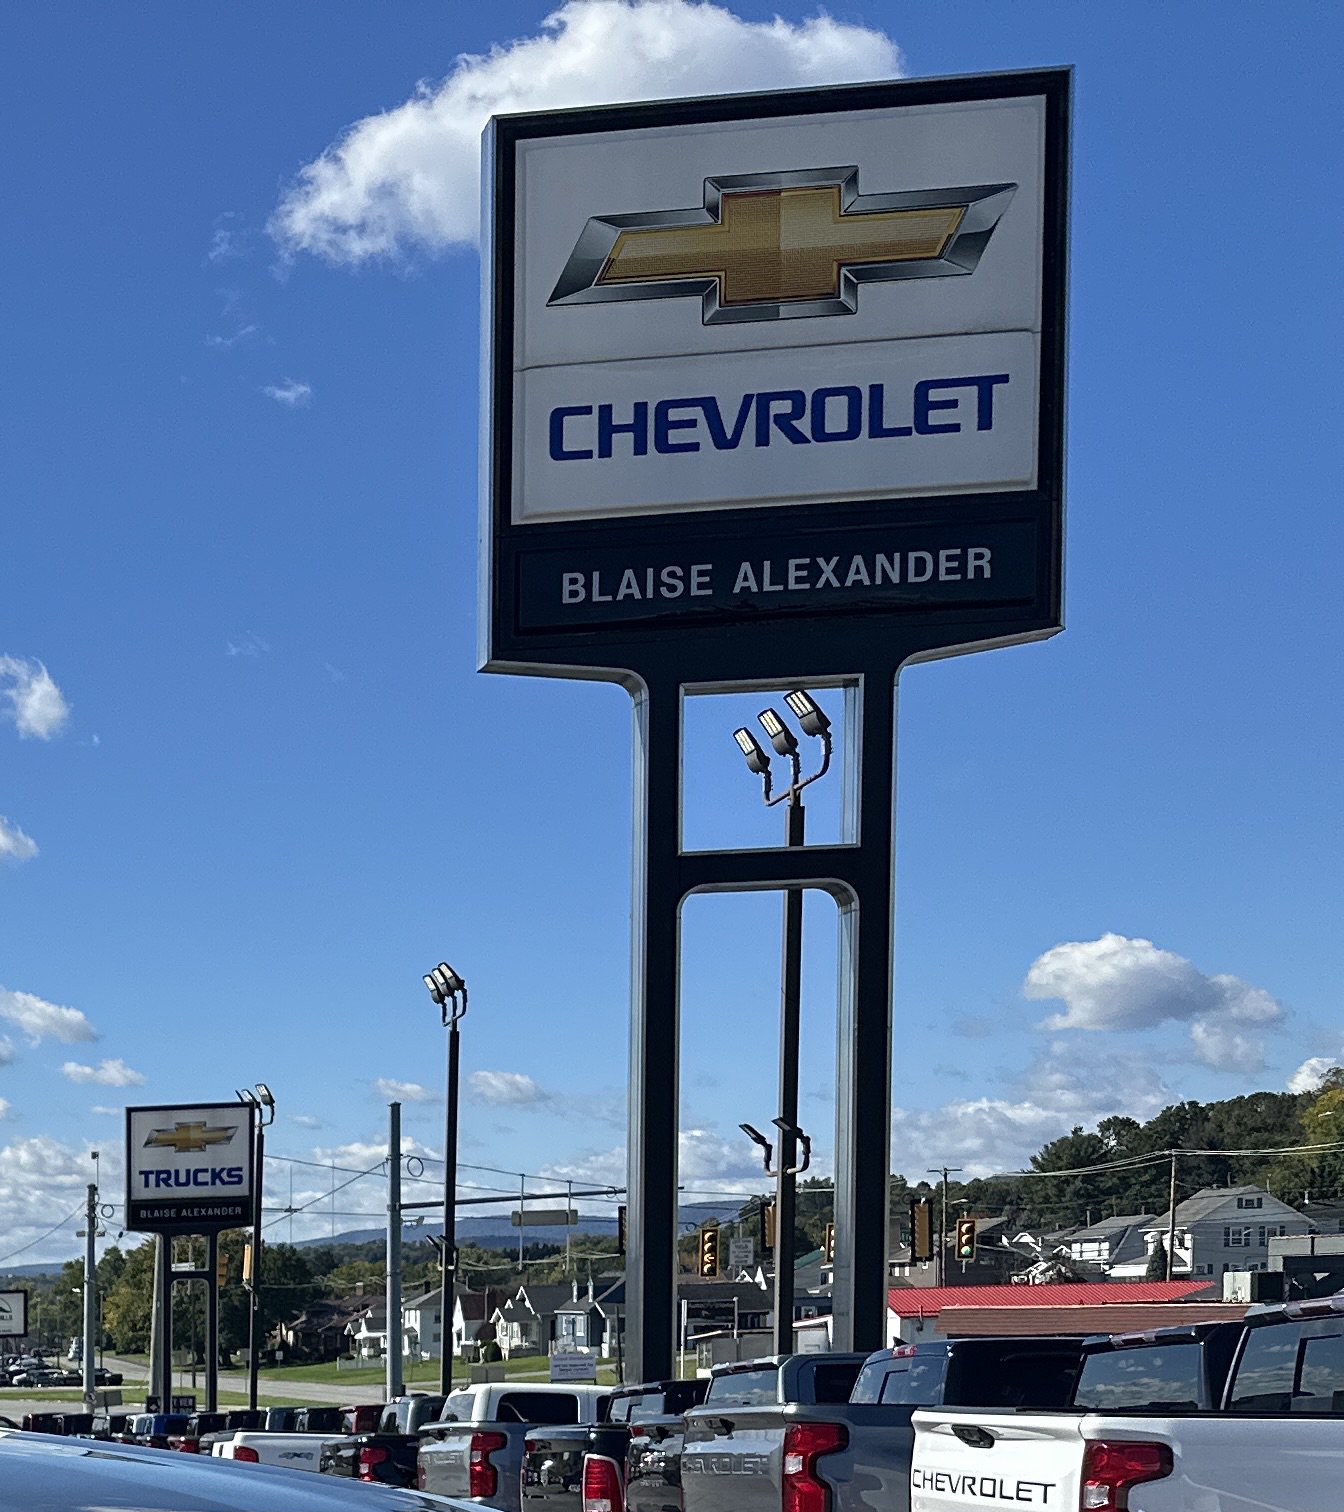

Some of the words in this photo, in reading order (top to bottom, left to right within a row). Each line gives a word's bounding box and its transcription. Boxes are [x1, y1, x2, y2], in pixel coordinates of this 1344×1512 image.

[548, 373, 1010, 461] CHEVROLET
[561, 562, 713, 605] BLAISE
[732, 546, 993, 594] ALEXANDER
[138, 1166, 244, 1188] TRUCKS
[139, 1208, 177, 1218] BLAISE
[180, 1206, 242, 1217] ALEXANDER
[912, 1468, 1057, 1504] CHEVROLET
